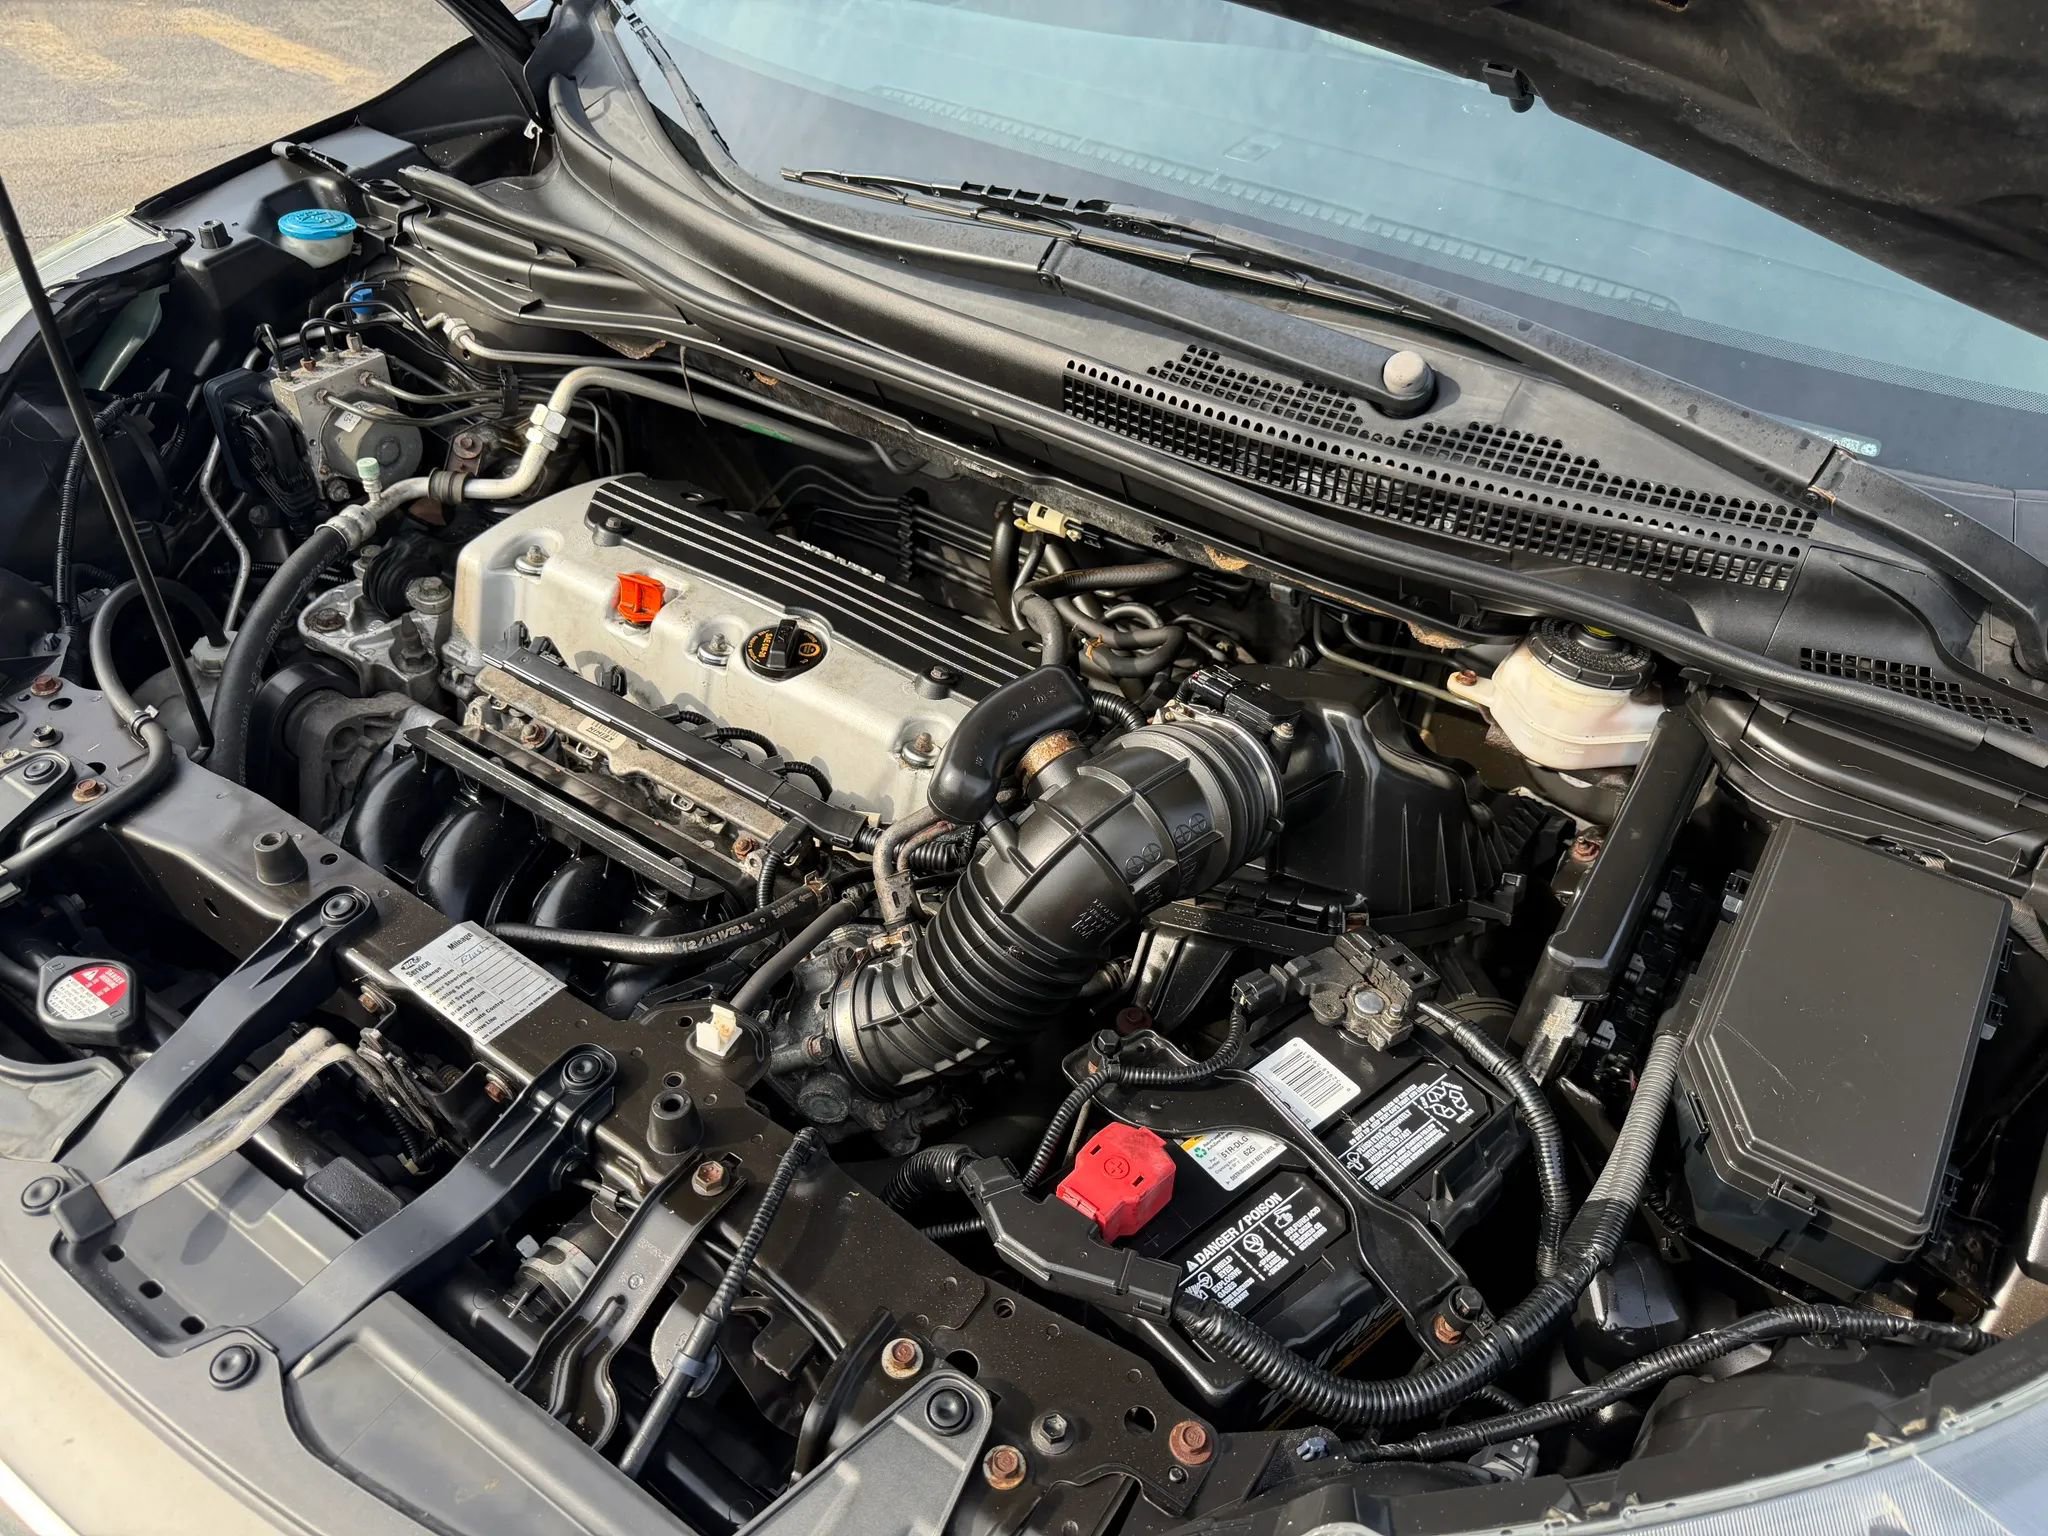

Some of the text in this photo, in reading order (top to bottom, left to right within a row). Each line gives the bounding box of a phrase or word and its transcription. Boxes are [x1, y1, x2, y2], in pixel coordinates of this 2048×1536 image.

[447, 931, 473, 950] Mileage
[406, 960, 431, 978] Service
[421, 966, 441, 980] Change
[444, 970, 467, 986] Steering
[455, 975, 475, 989] System
[454, 986, 474, 1001] System
[465, 989, 486, 1004] System
[457, 1006, 478, 1021] Battery
[465, 998, 505, 1027] Climate Control
[1220, 1135, 1248, 1158] 51R-DLG
[1242, 1144, 1256, 1156] 625
[1229, 1163, 1252, 1181] DISTRIBUTED
[1193, 1191, 1283, 1263] DANGER / POISON
[1282, 1205, 1321, 1237] SULFURIC ACID
[1256, 1247, 1269, 1258] NO
[1210, 1254, 1233, 1273] SHIELD
[1216, 1263, 1234, 1278] EYES
[1210, 1266, 1242, 1293] EXPLOSIVE
[1216, 1280, 1237, 1298] GASES
